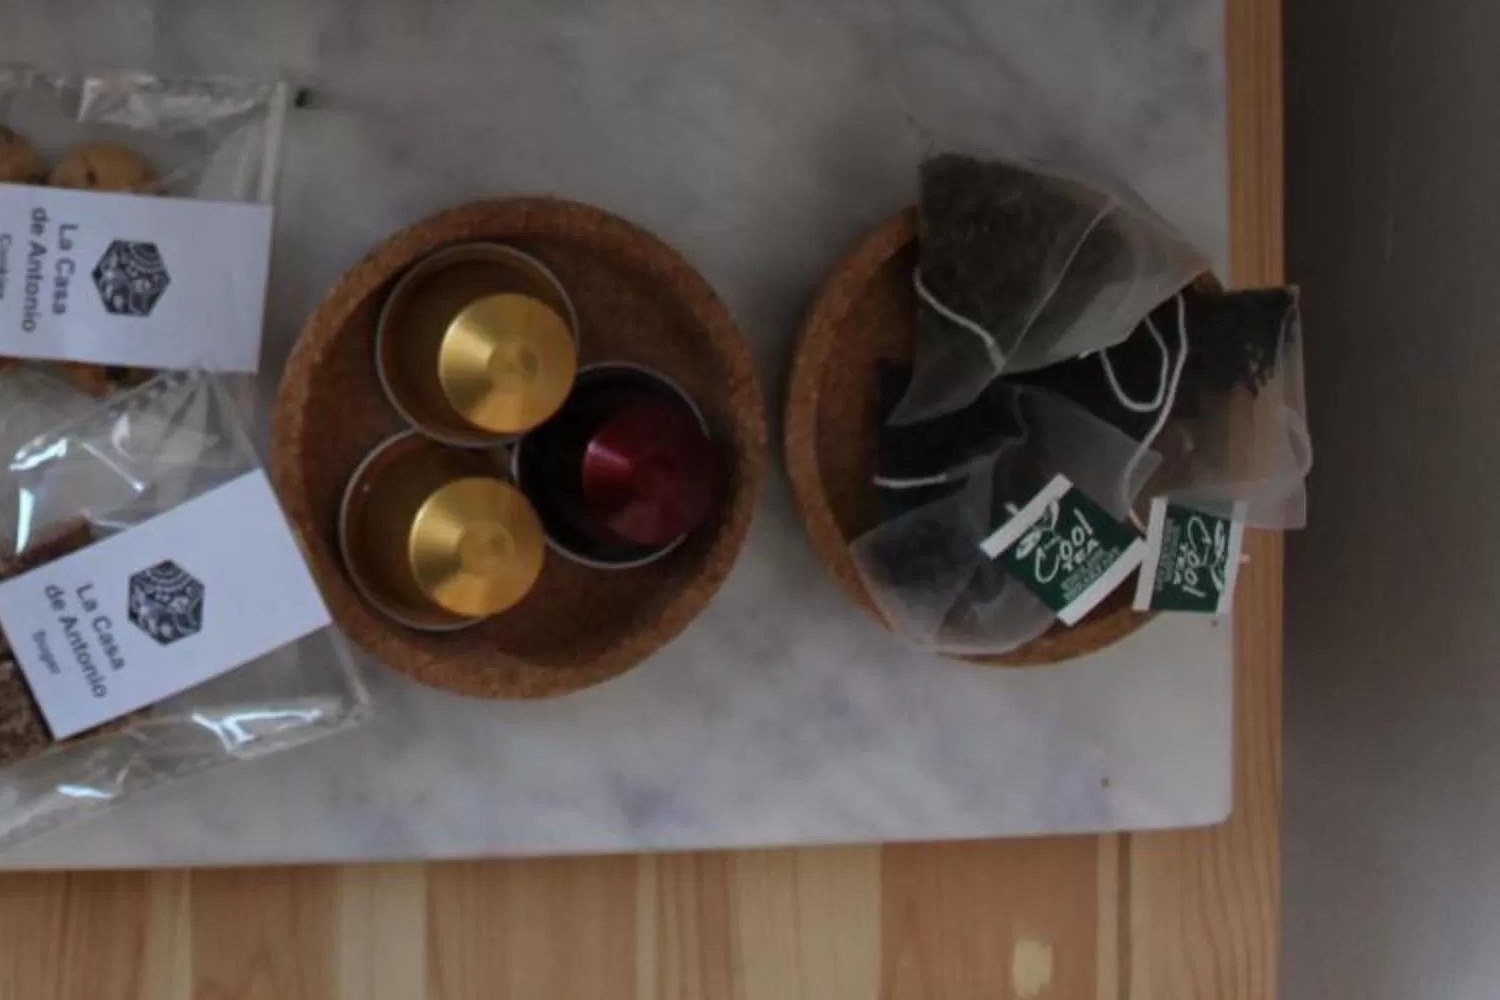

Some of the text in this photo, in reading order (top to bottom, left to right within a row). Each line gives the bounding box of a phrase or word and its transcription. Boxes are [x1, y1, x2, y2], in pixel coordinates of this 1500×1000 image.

[21, 207, 49, 333] de Antonio
[52, 223, 78, 315] La Casa
[44, 584, 108, 699] de Antonio
[76, 582, 125, 671] La Casa
